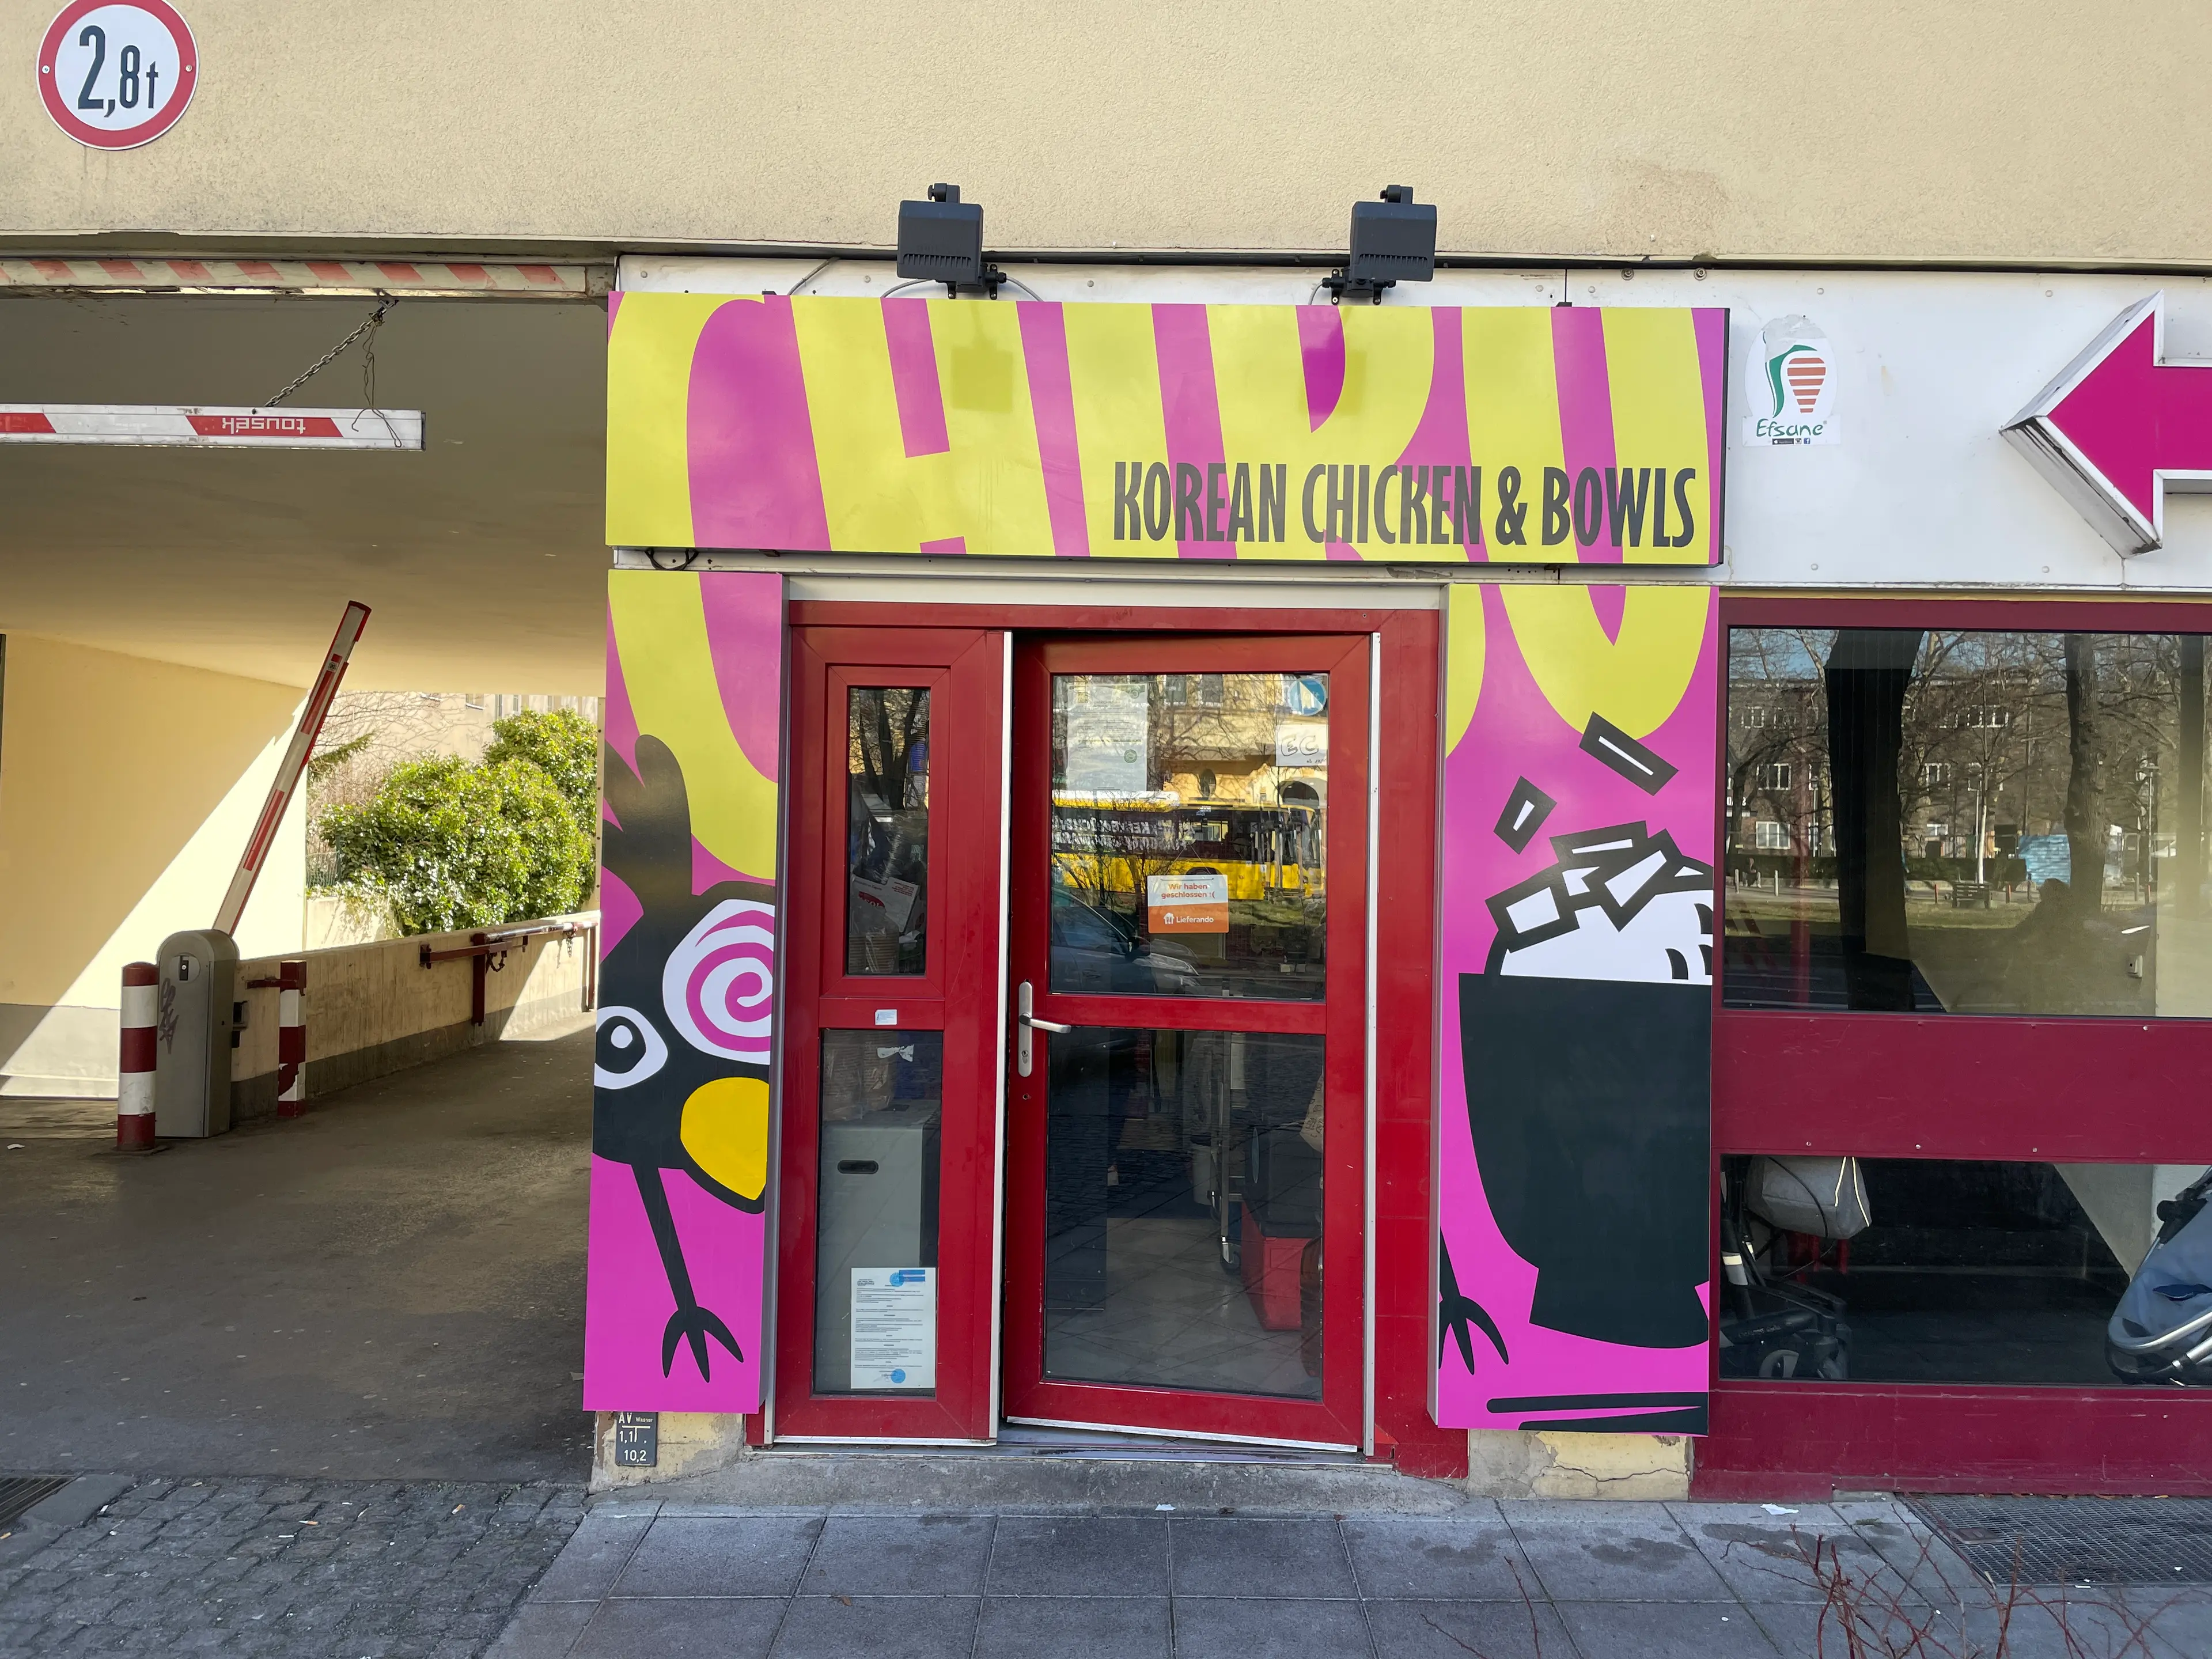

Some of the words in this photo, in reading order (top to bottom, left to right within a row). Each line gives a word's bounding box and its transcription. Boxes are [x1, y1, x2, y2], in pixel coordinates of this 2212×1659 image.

[1756, 418, 1823, 437] Efsane
[1113, 461, 1286, 542] KOREAN
[1302, 464, 1482, 544] CHICKEN
[1495, 466, 1528, 546] &
[1542, 467, 1696, 548] BOWLS
[1161, 891, 1207, 899] geschlossen
[624, 1449, 647, 1463] 10,2
